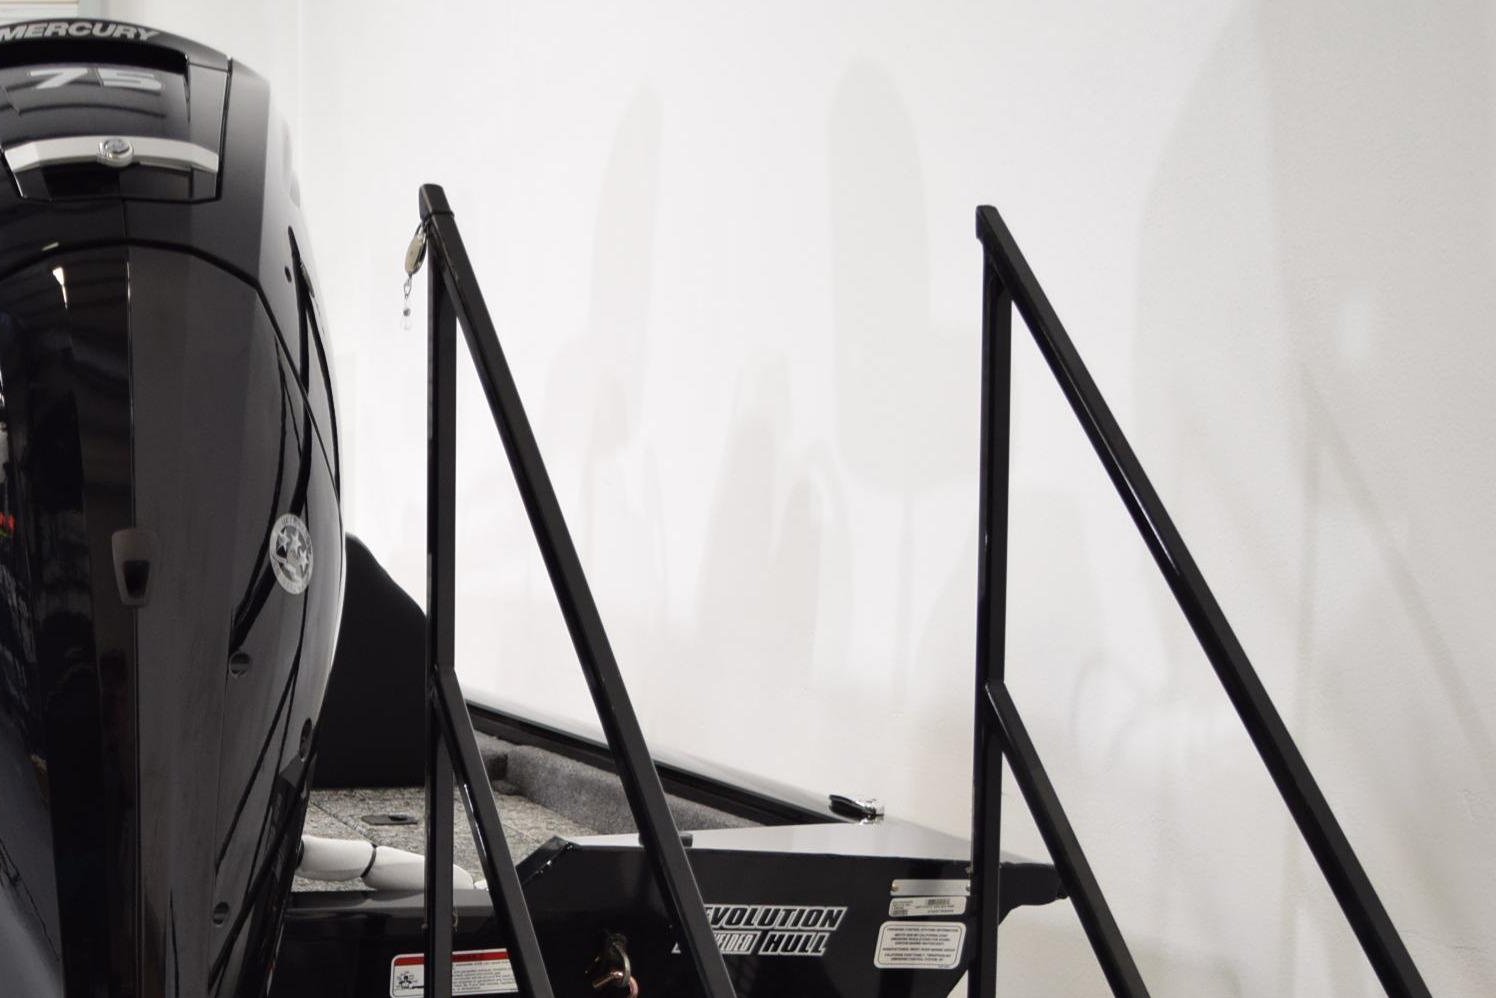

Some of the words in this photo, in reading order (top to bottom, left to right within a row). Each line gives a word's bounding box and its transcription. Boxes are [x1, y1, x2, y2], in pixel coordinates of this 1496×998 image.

[29, 67, 163, 91] 75
[704, 905, 846, 930] VOLUTION
[759, 932, 829, 955] HULL
